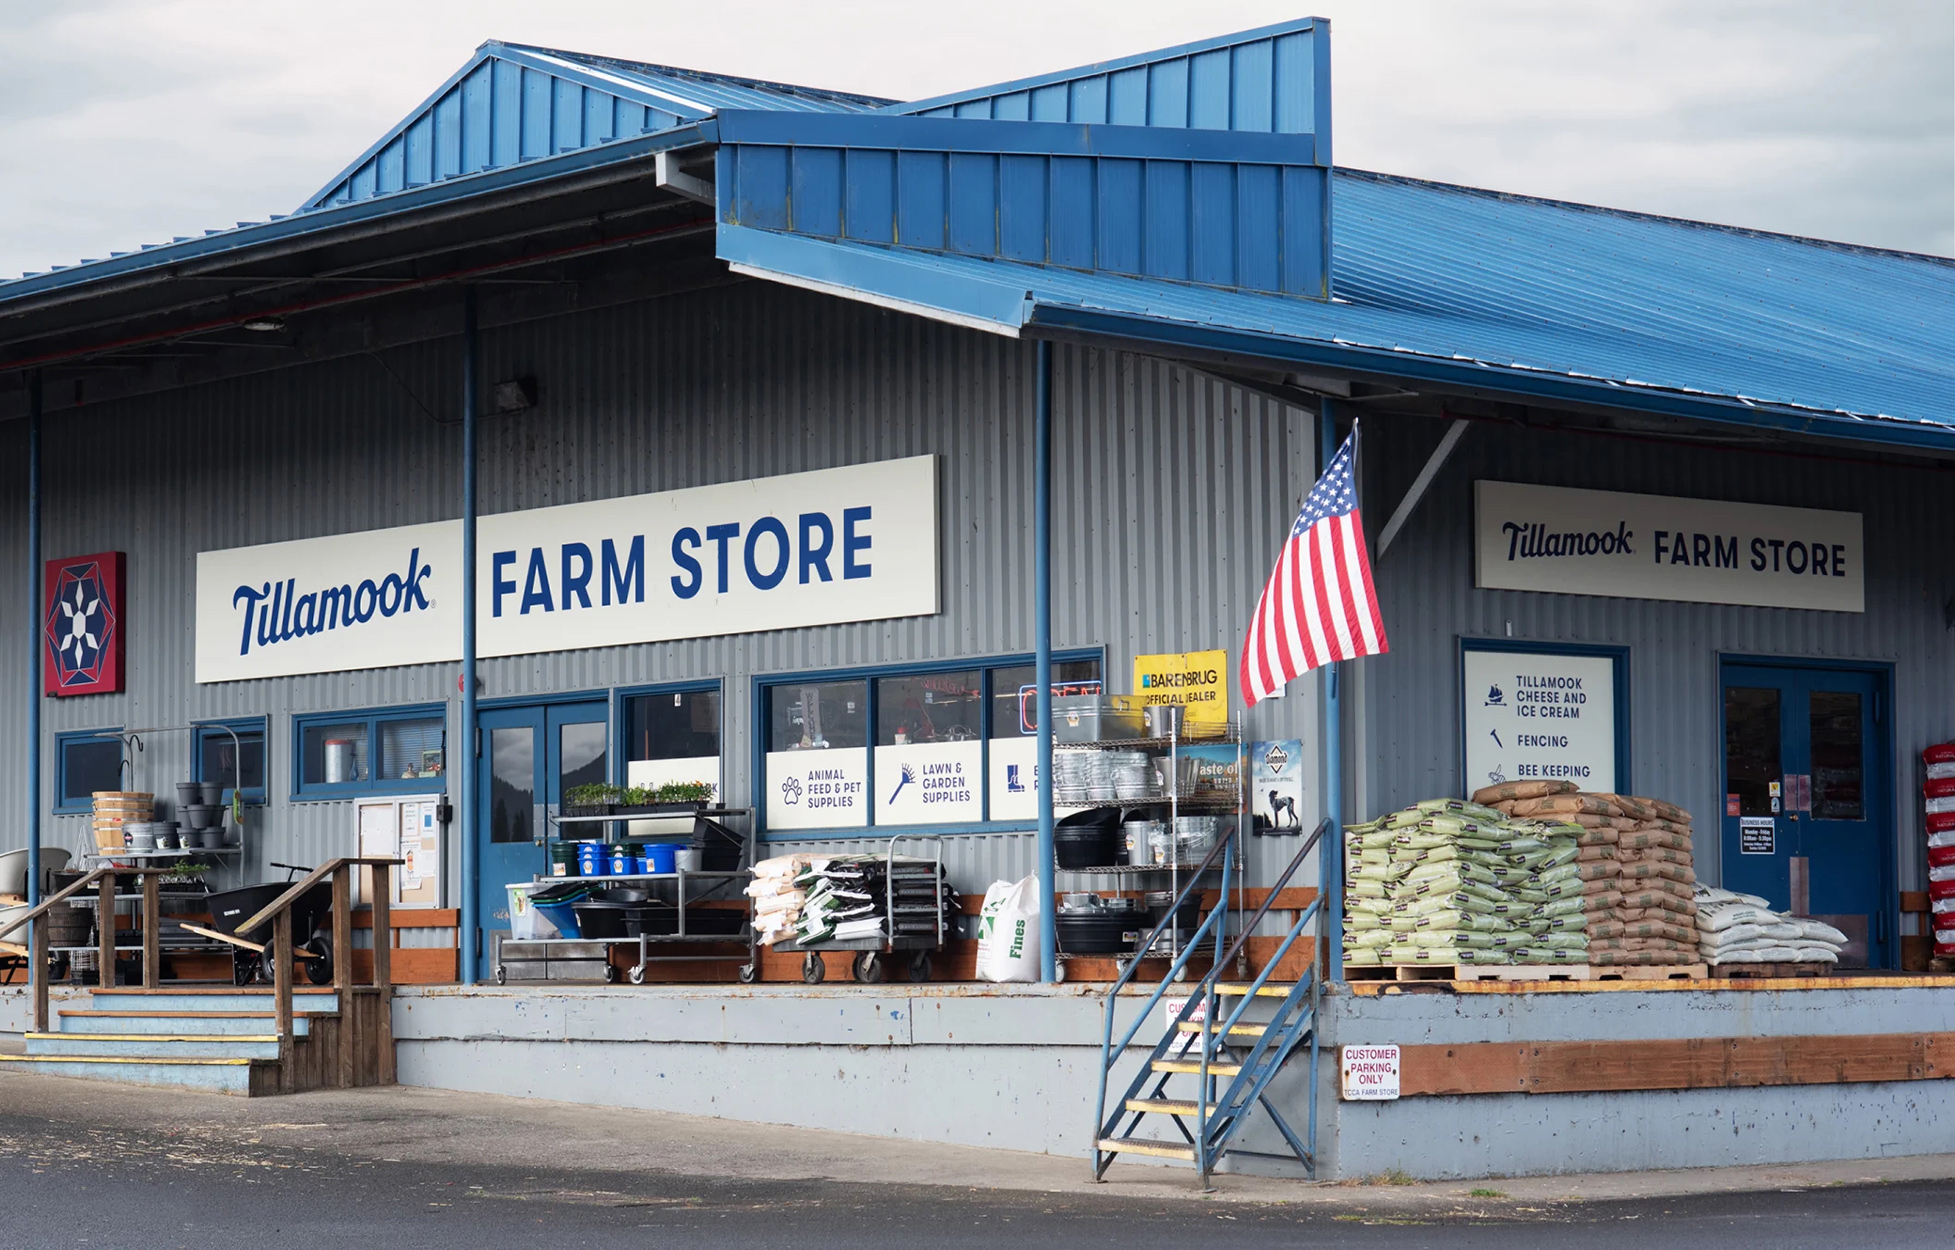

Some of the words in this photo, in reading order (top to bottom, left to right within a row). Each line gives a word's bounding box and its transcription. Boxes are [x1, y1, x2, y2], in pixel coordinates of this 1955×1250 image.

[1503, 521, 1634, 561] Tillamook
[1655, 530, 1739, 569] FARM
[1750, 537, 1846, 577] STORE
[233, 547, 432, 656] Tillamook
[492, 534, 645, 618] FARM
[670, 505, 872, 600] STORE
[1516, 675, 1582, 689] TILLAMOOK
[1516, 690, 1560, 703] CHEESE
[1563, 692, 1587, 704] AND
[1517, 705, 1536, 717] ICE
[1540, 706, 1580, 719] CREAM
[1517, 735, 1569, 748] FENCING
[808, 769, 845, 781] ANIMAL
[923, 763, 952, 775] LAWN
[955, 762, 962, 773] &
[1200, 764, 1224, 776] aste
[1518, 764, 1539, 776] BEE
[1542, 765, 1591, 778] KEEPING
[808, 784, 831, 795] FEED
[834, 783, 841, 793] &
[844, 782, 862, 793] PET
[923, 776, 965, 789] GARDEN
[808, 796, 853, 809] SUPPLIES
[923, 790, 971, 804] SUPPLIES
[1009, 919, 1026, 959] Fines
[1168, 1003, 1206, 1013] CUSOM
[1345, 1049, 1397, 1060] CUSTOMER
[1350, 1063, 1392, 1073] PARKING
[1358, 1074, 1384, 1085] ONLY
[1379, 1088, 1398, 1096] STORE
